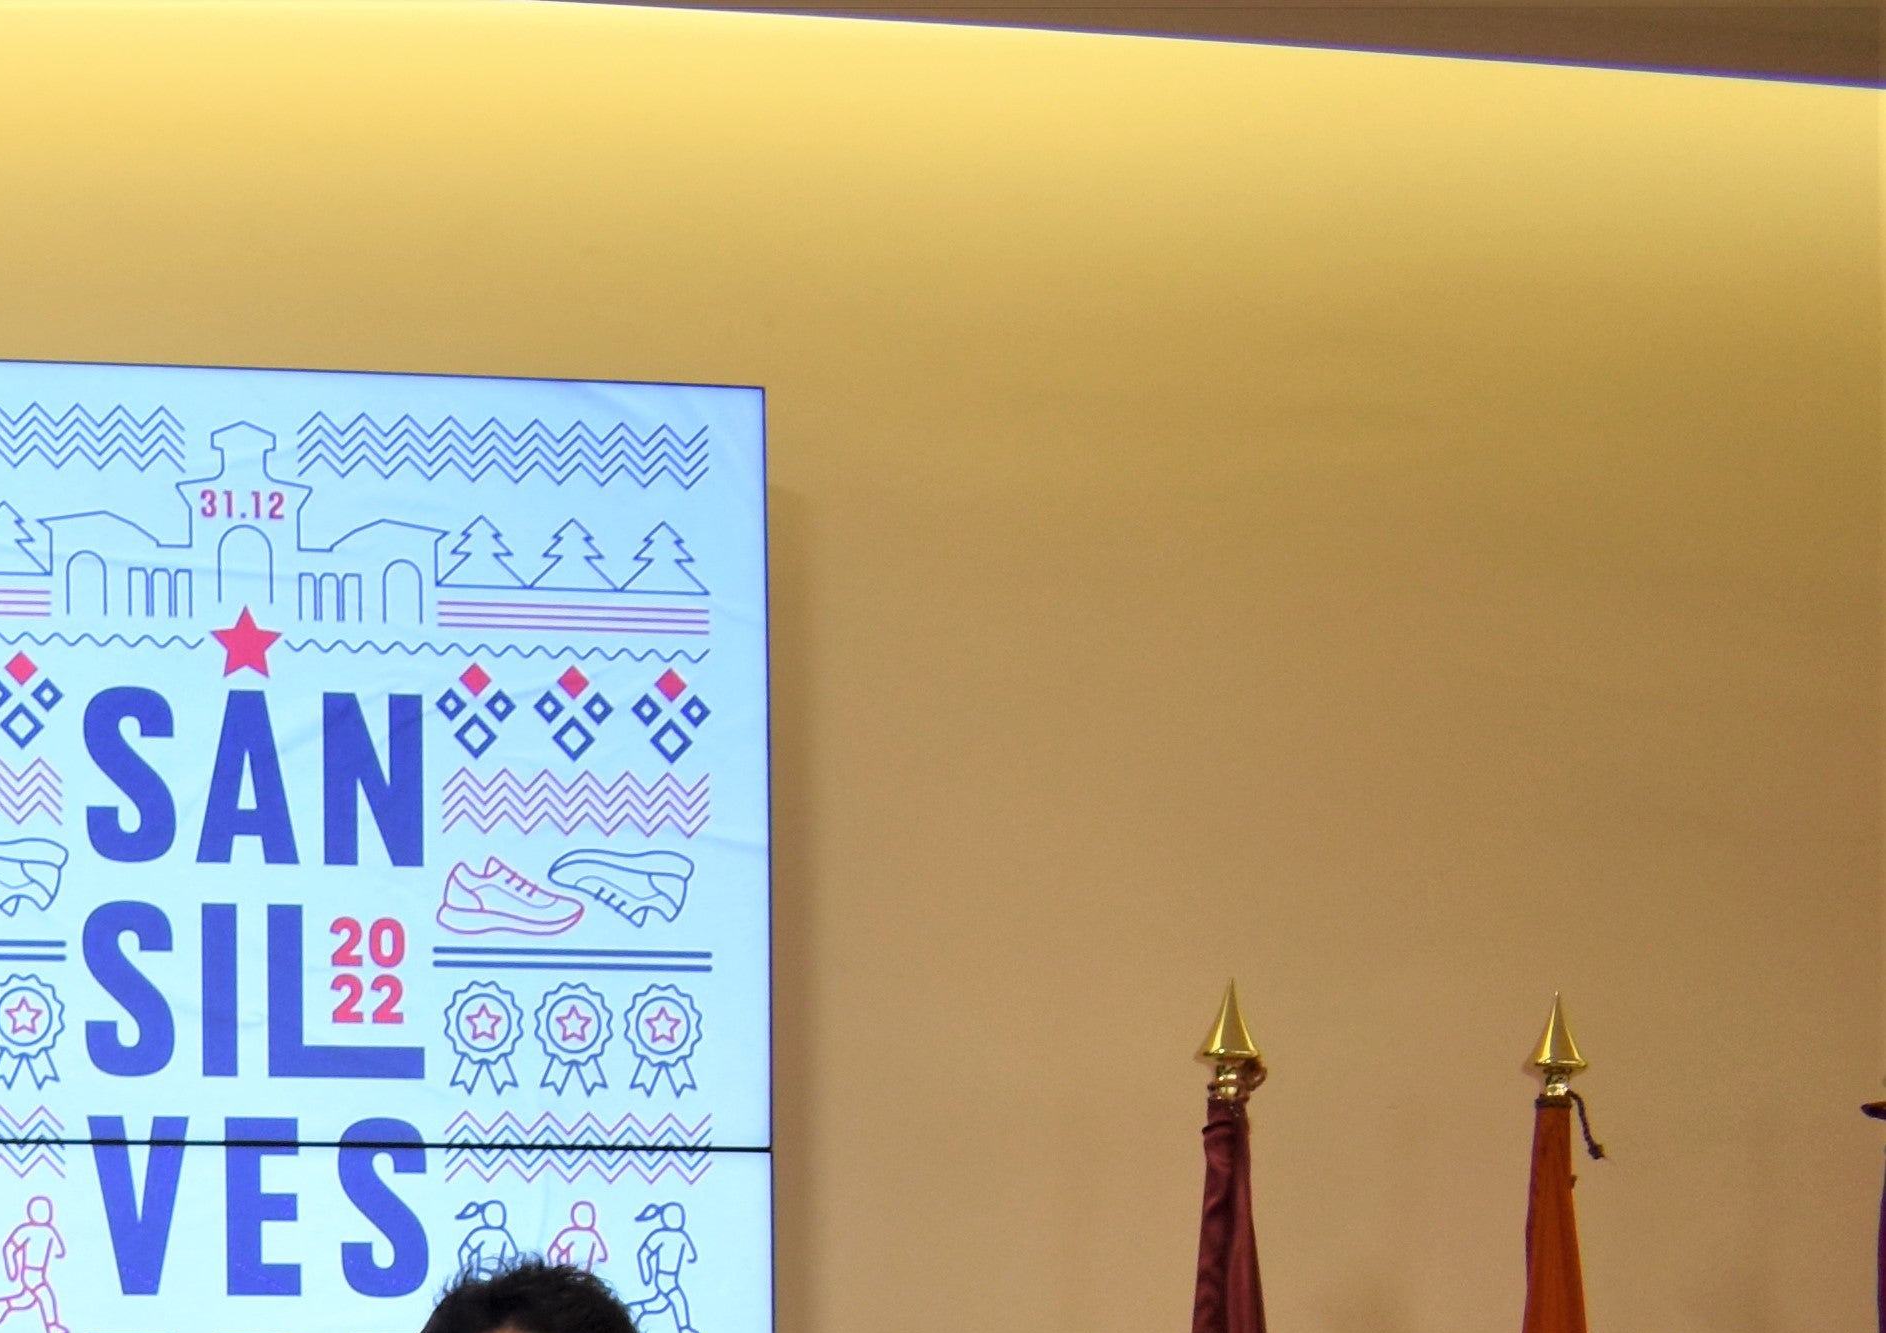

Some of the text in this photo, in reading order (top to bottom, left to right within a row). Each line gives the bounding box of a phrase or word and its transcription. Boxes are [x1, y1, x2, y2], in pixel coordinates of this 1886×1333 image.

[201, 490, 286, 521] 31.12
[82, 685, 425, 867] SAN
[81, 900, 425, 1078] SIL
[330, 917, 405, 968] 20
[330, 973, 404, 1025] 22
[88, 1115, 428, 1298] VES
